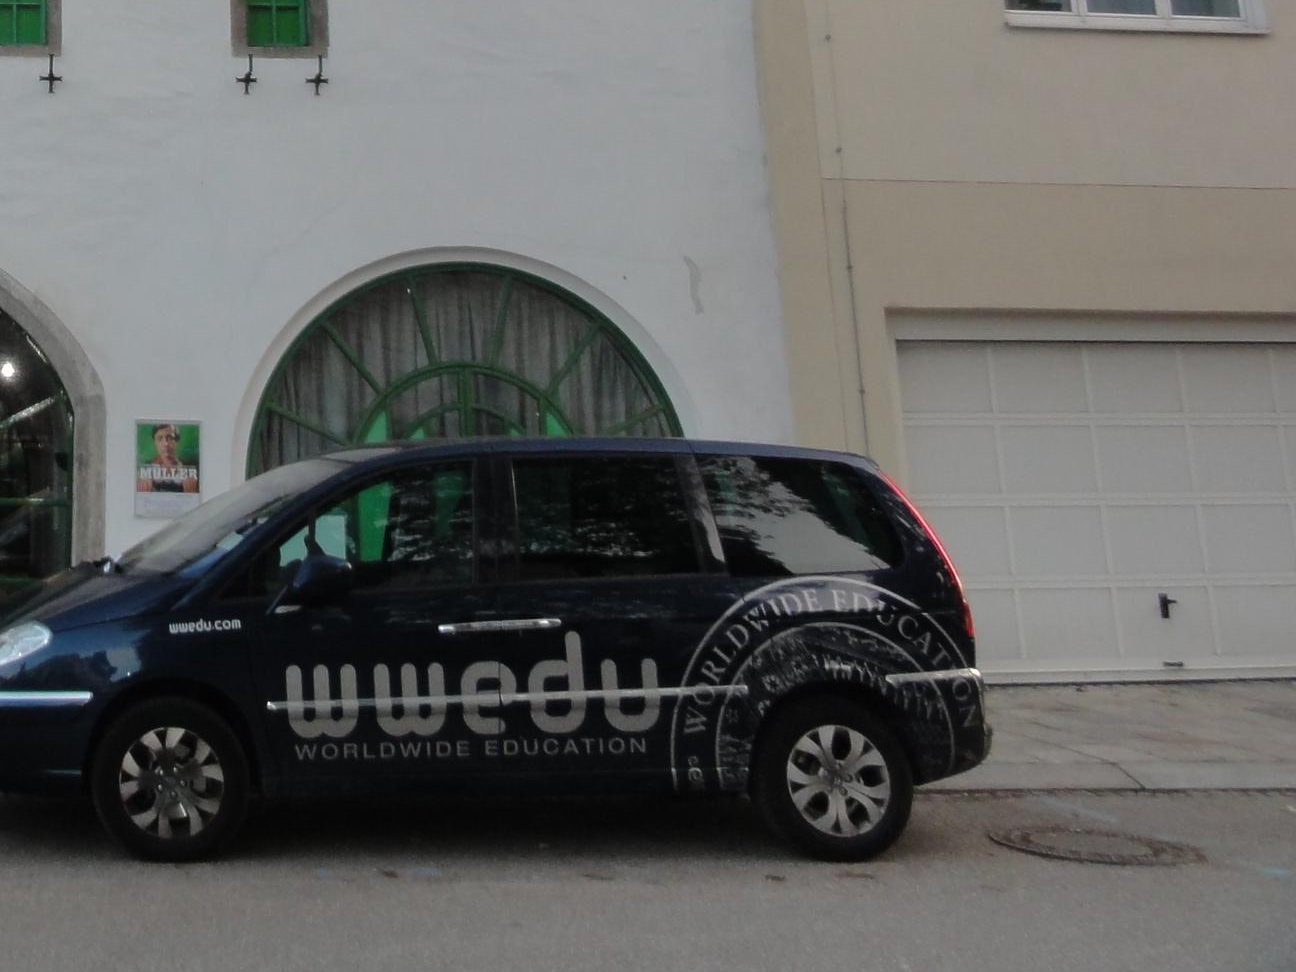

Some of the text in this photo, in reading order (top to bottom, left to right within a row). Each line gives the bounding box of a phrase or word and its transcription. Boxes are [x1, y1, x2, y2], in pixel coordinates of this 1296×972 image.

[168, 618, 242, 634] wwedu.com
[831, 588, 976, 728] EDUCATON
[285, 630, 661, 739] wwedu
[294, 736, 648, 761] WORLDWIDE EDUCATION
